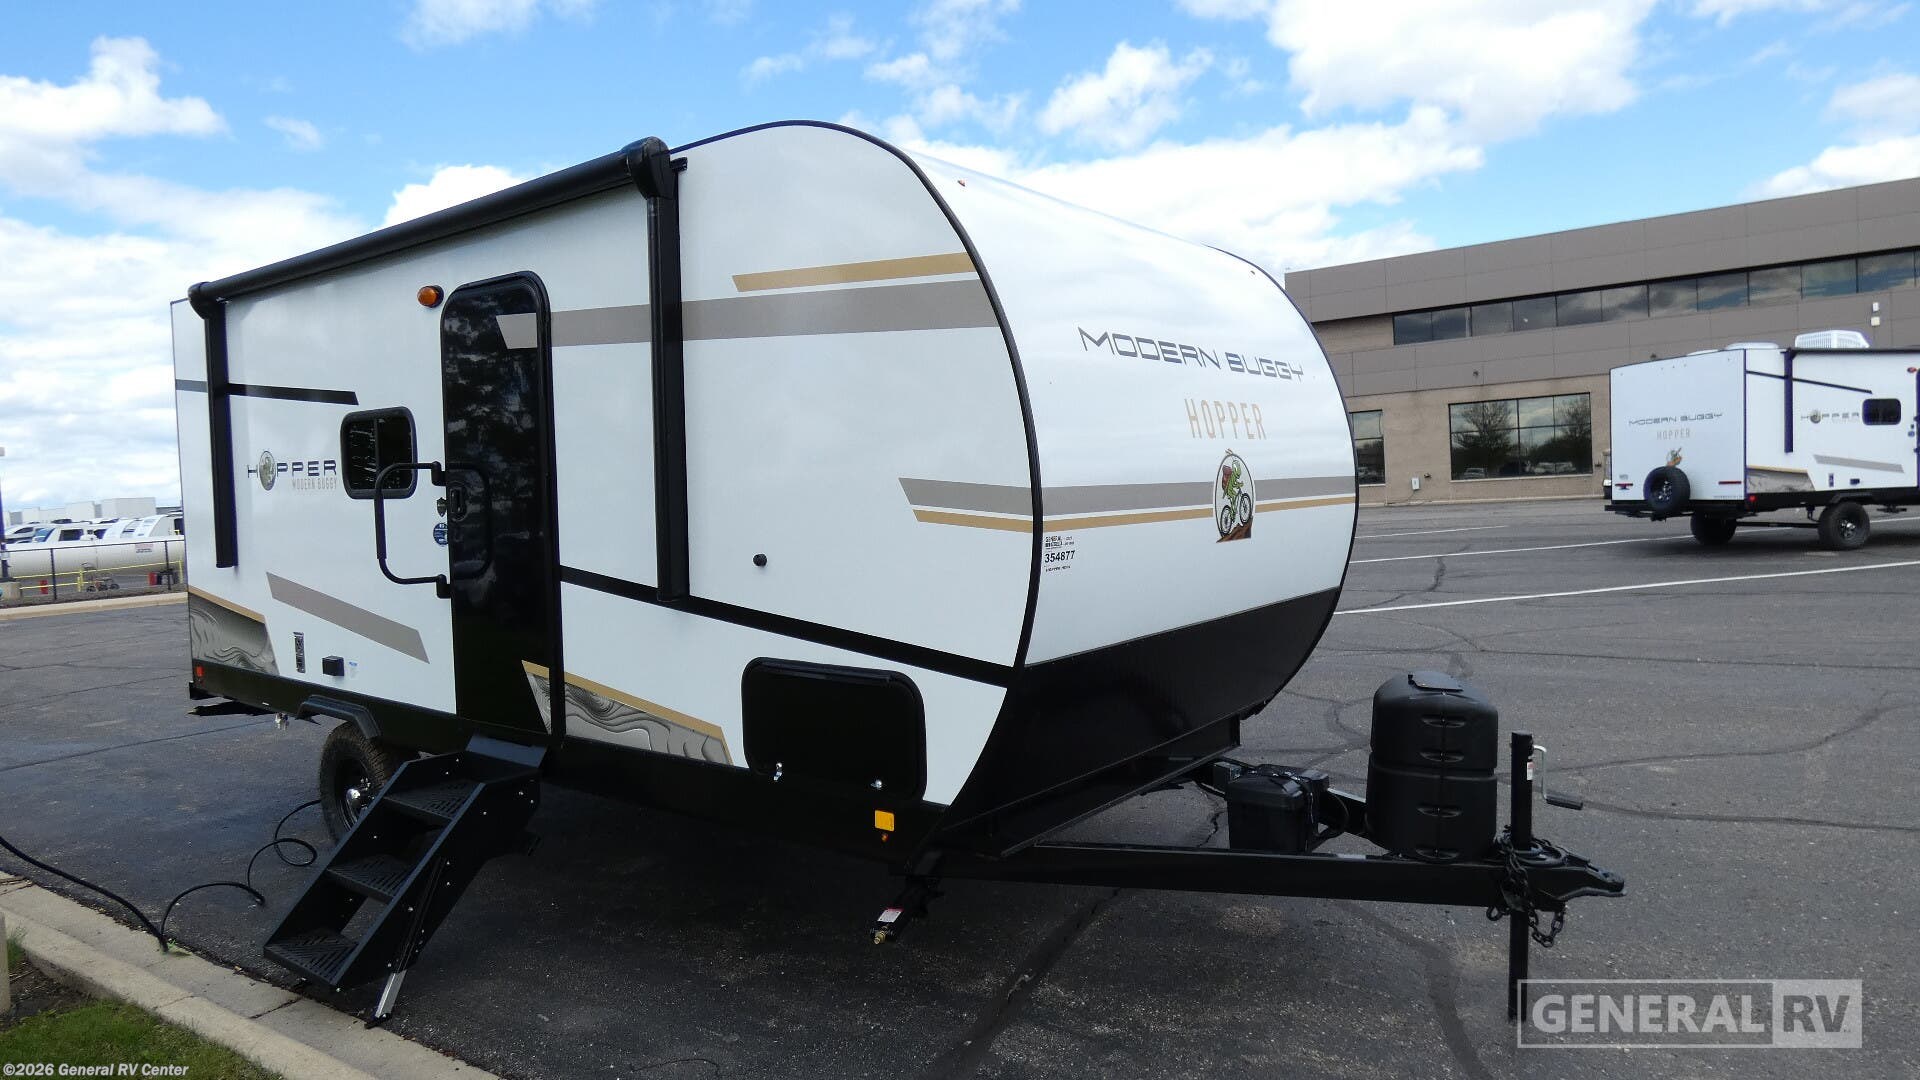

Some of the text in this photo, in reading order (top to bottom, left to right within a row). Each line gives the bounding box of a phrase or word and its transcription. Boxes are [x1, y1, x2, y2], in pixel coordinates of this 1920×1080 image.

[1078, 326, 1304, 382] MODERN BUGGY
[1184, 398, 1267, 439] HOPPER
[1628, 412, 1722, 425] MODERN BUGGY
[247, 450, 337, 491] HOPPER
[1045, 550, 1075, 563] 354877
